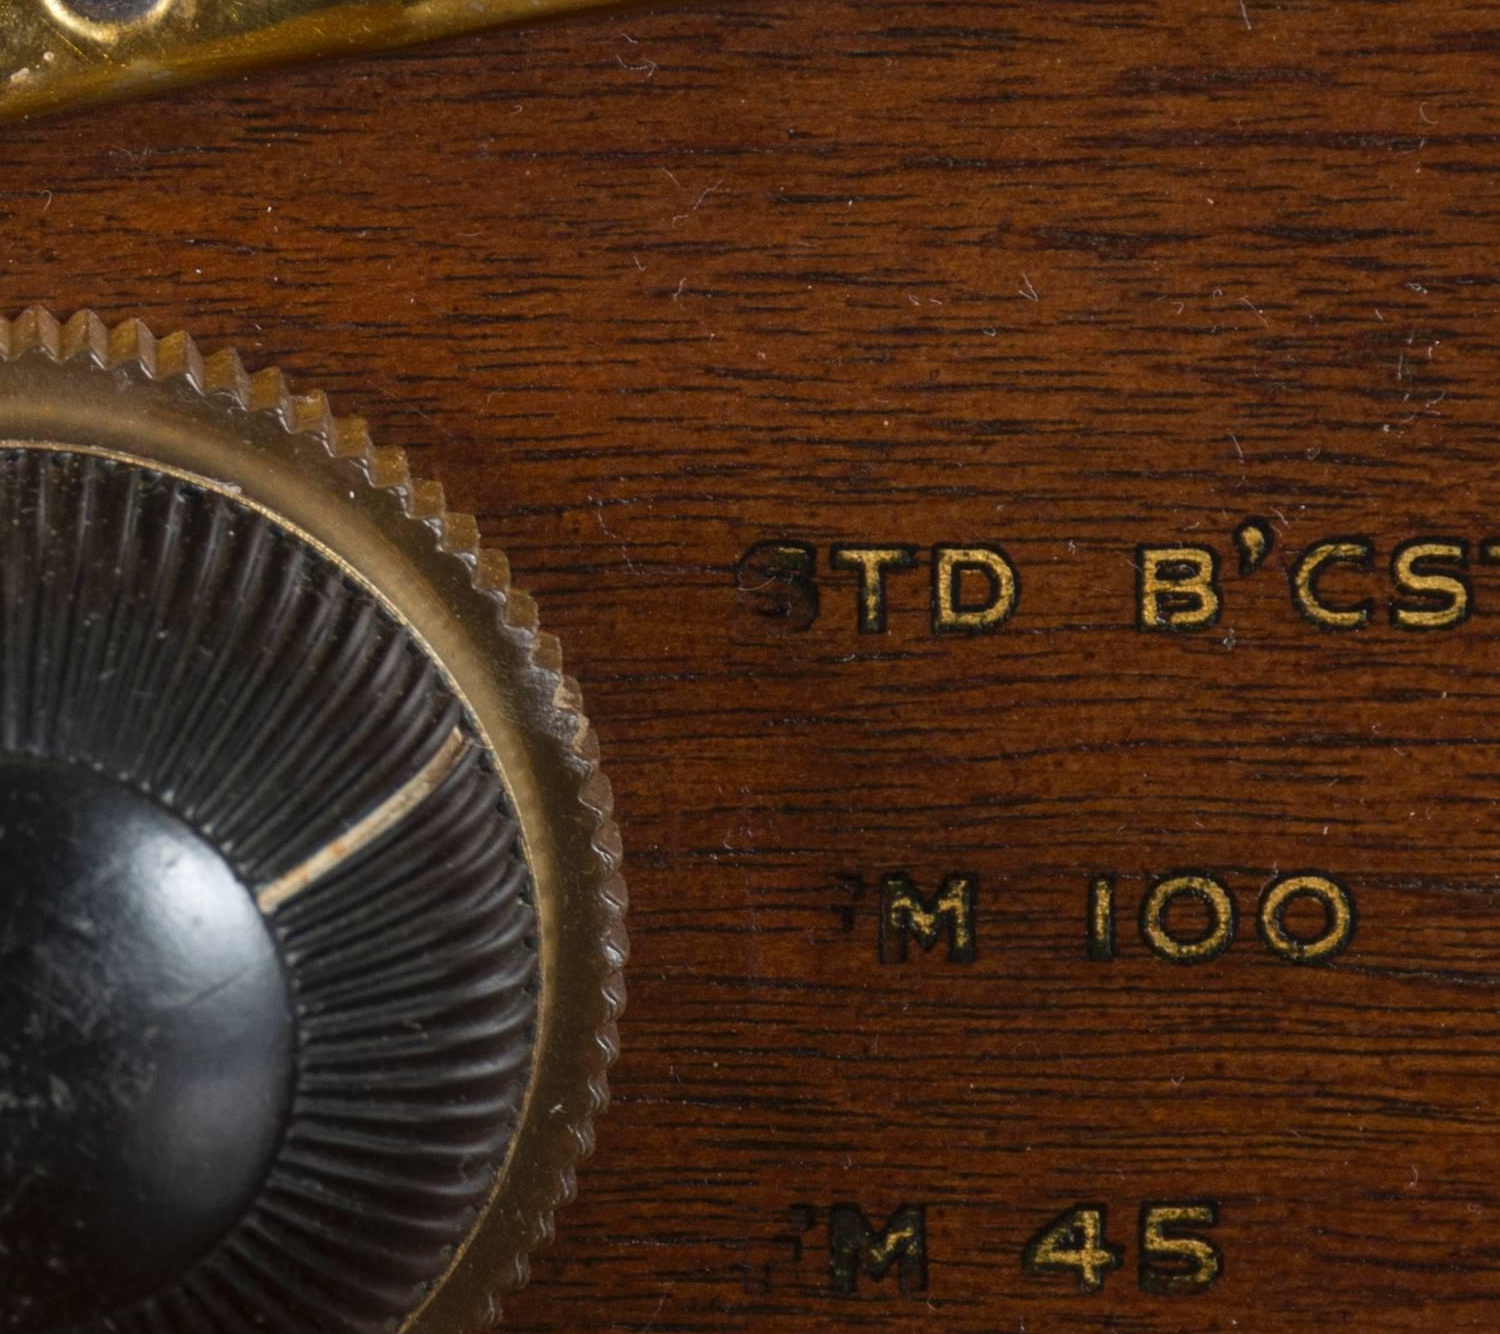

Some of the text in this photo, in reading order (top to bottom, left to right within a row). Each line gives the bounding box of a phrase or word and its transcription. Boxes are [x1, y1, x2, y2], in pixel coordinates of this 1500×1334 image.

[831, 869, 1358, 965] M 100
[748, 1200, 1227, 1294] M 45
